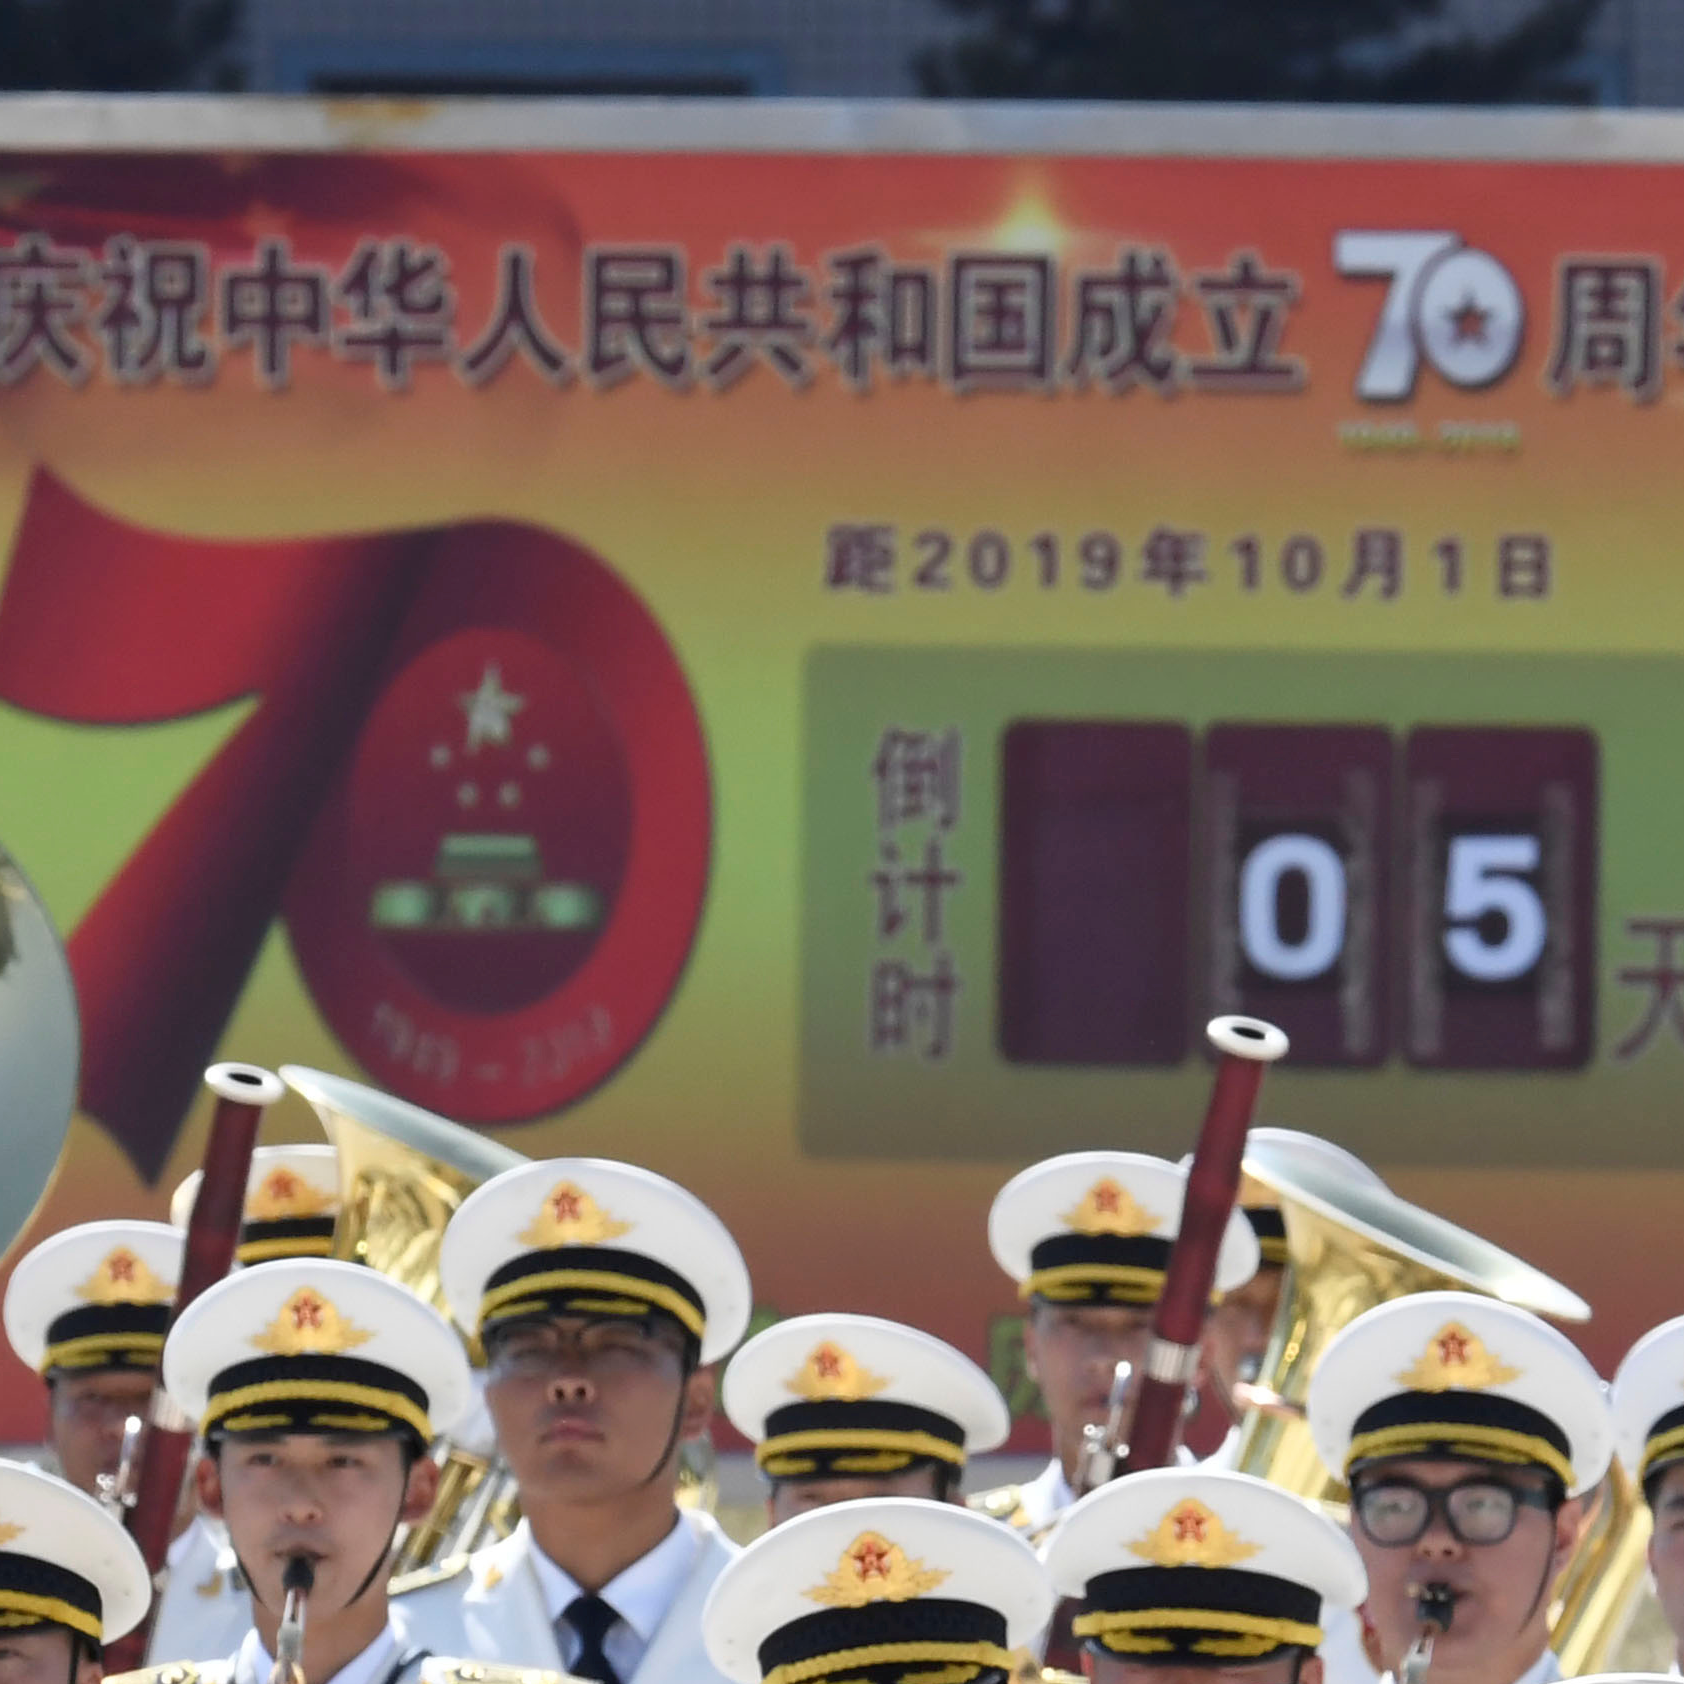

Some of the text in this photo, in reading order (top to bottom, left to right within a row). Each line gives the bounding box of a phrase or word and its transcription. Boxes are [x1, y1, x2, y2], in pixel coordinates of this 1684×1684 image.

[826, 522, 1551, 600] 距2019年10月1日
[871, 727, 963, 1062] 倒计时
